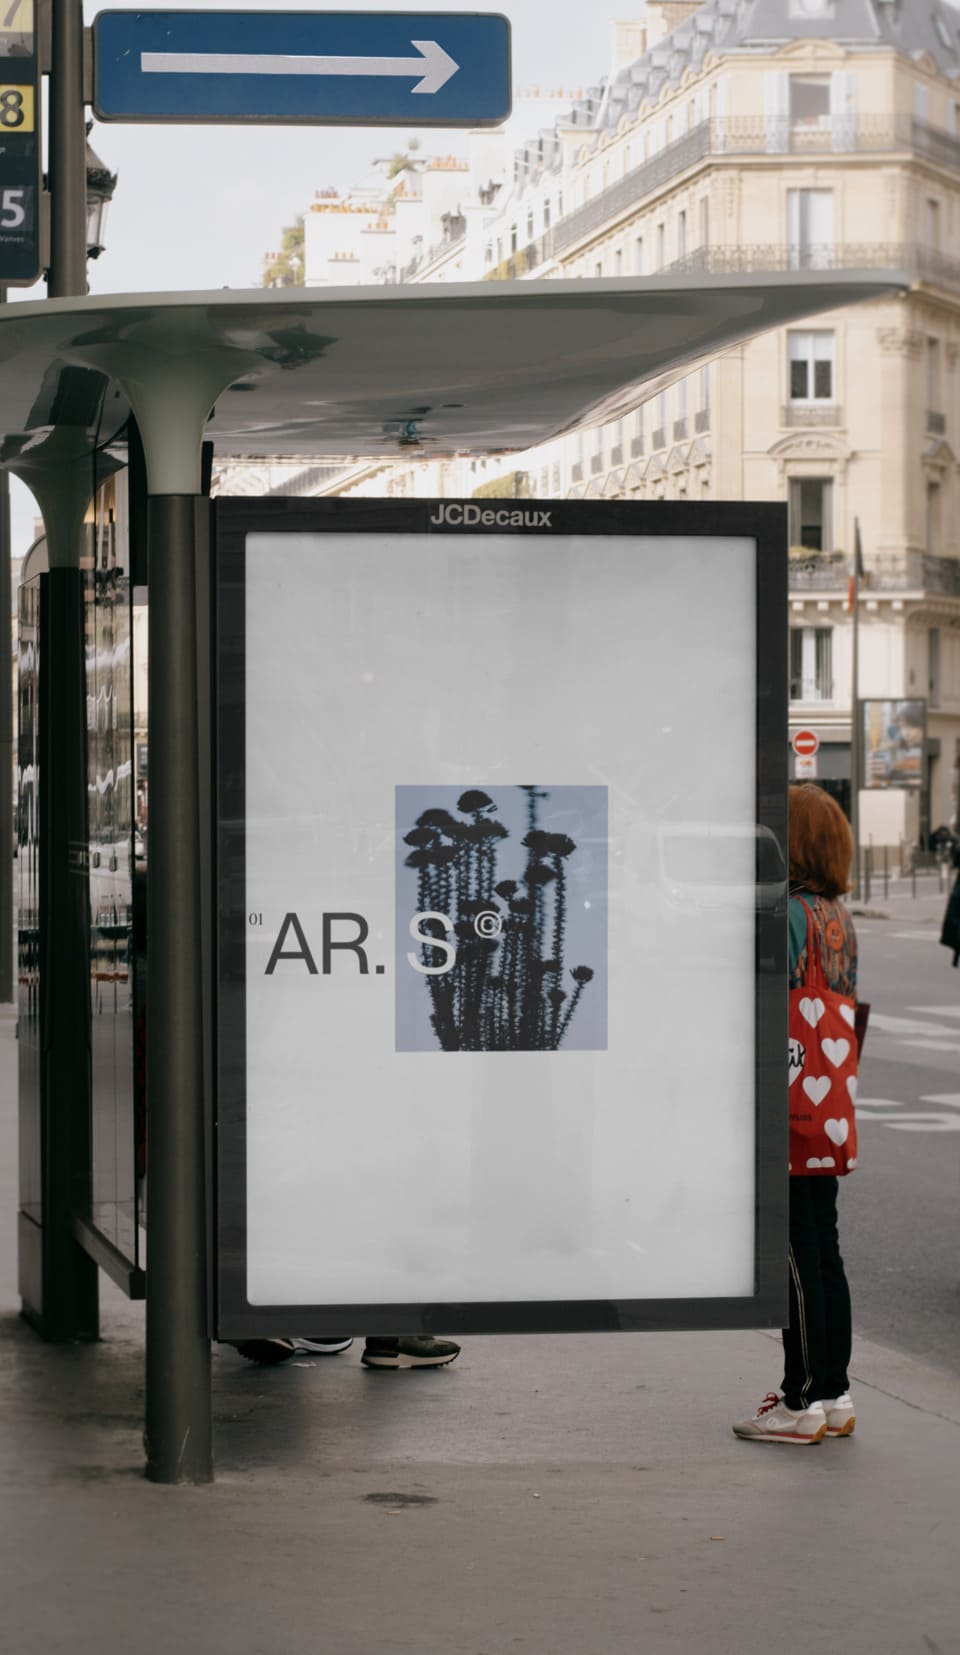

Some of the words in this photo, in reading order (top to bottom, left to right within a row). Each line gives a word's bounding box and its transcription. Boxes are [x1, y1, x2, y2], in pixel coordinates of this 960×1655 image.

[430, 503, 553, 527] JCDecaux
[248, 912, 263, 926] 01
[264, 912, 386, 975] AR.
[407, 911, 457, 976] S
